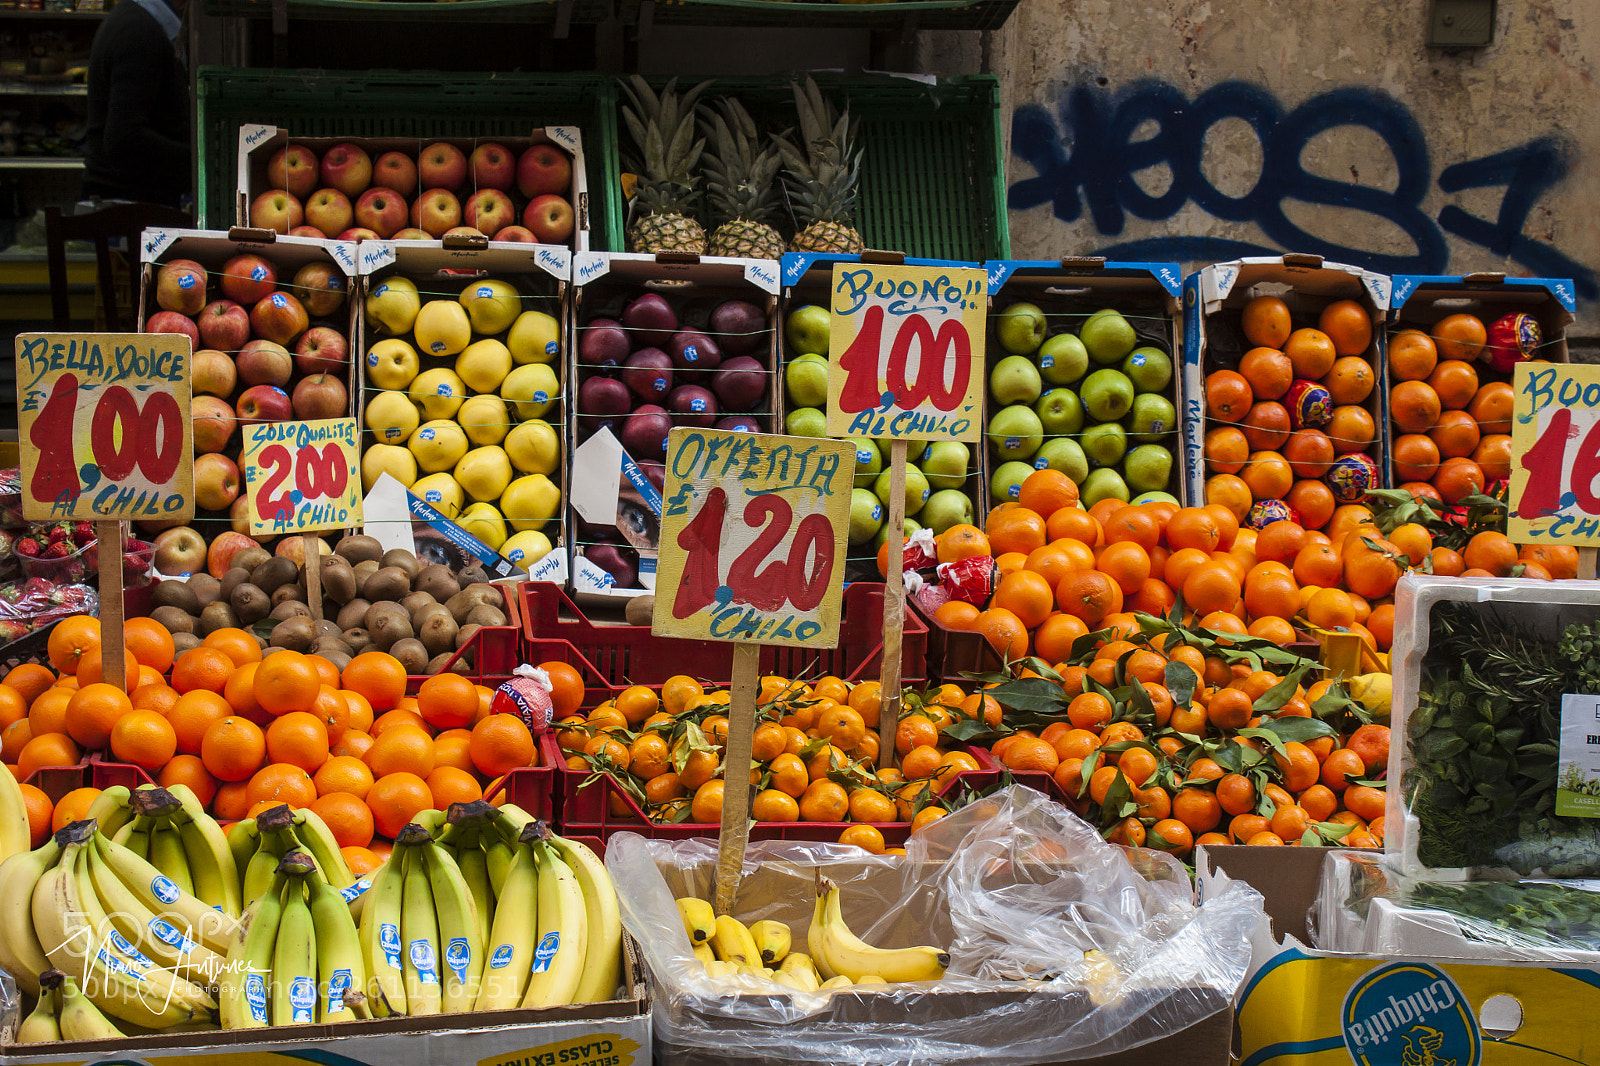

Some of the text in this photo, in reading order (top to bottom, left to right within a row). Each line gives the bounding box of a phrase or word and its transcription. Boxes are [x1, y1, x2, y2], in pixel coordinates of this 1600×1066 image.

[256, 442, 349, 521] 2,00
[624, 461, 647, 487] Marlene
[672, 432, 841, 497] OFFERTA
[92, 484, 185, 515] CHILO
[672, 486, 835, 620] 1,20
[1347, 978, 1457, 1048] Chiquita
[559, 1040, 614, 1063] CLASS
